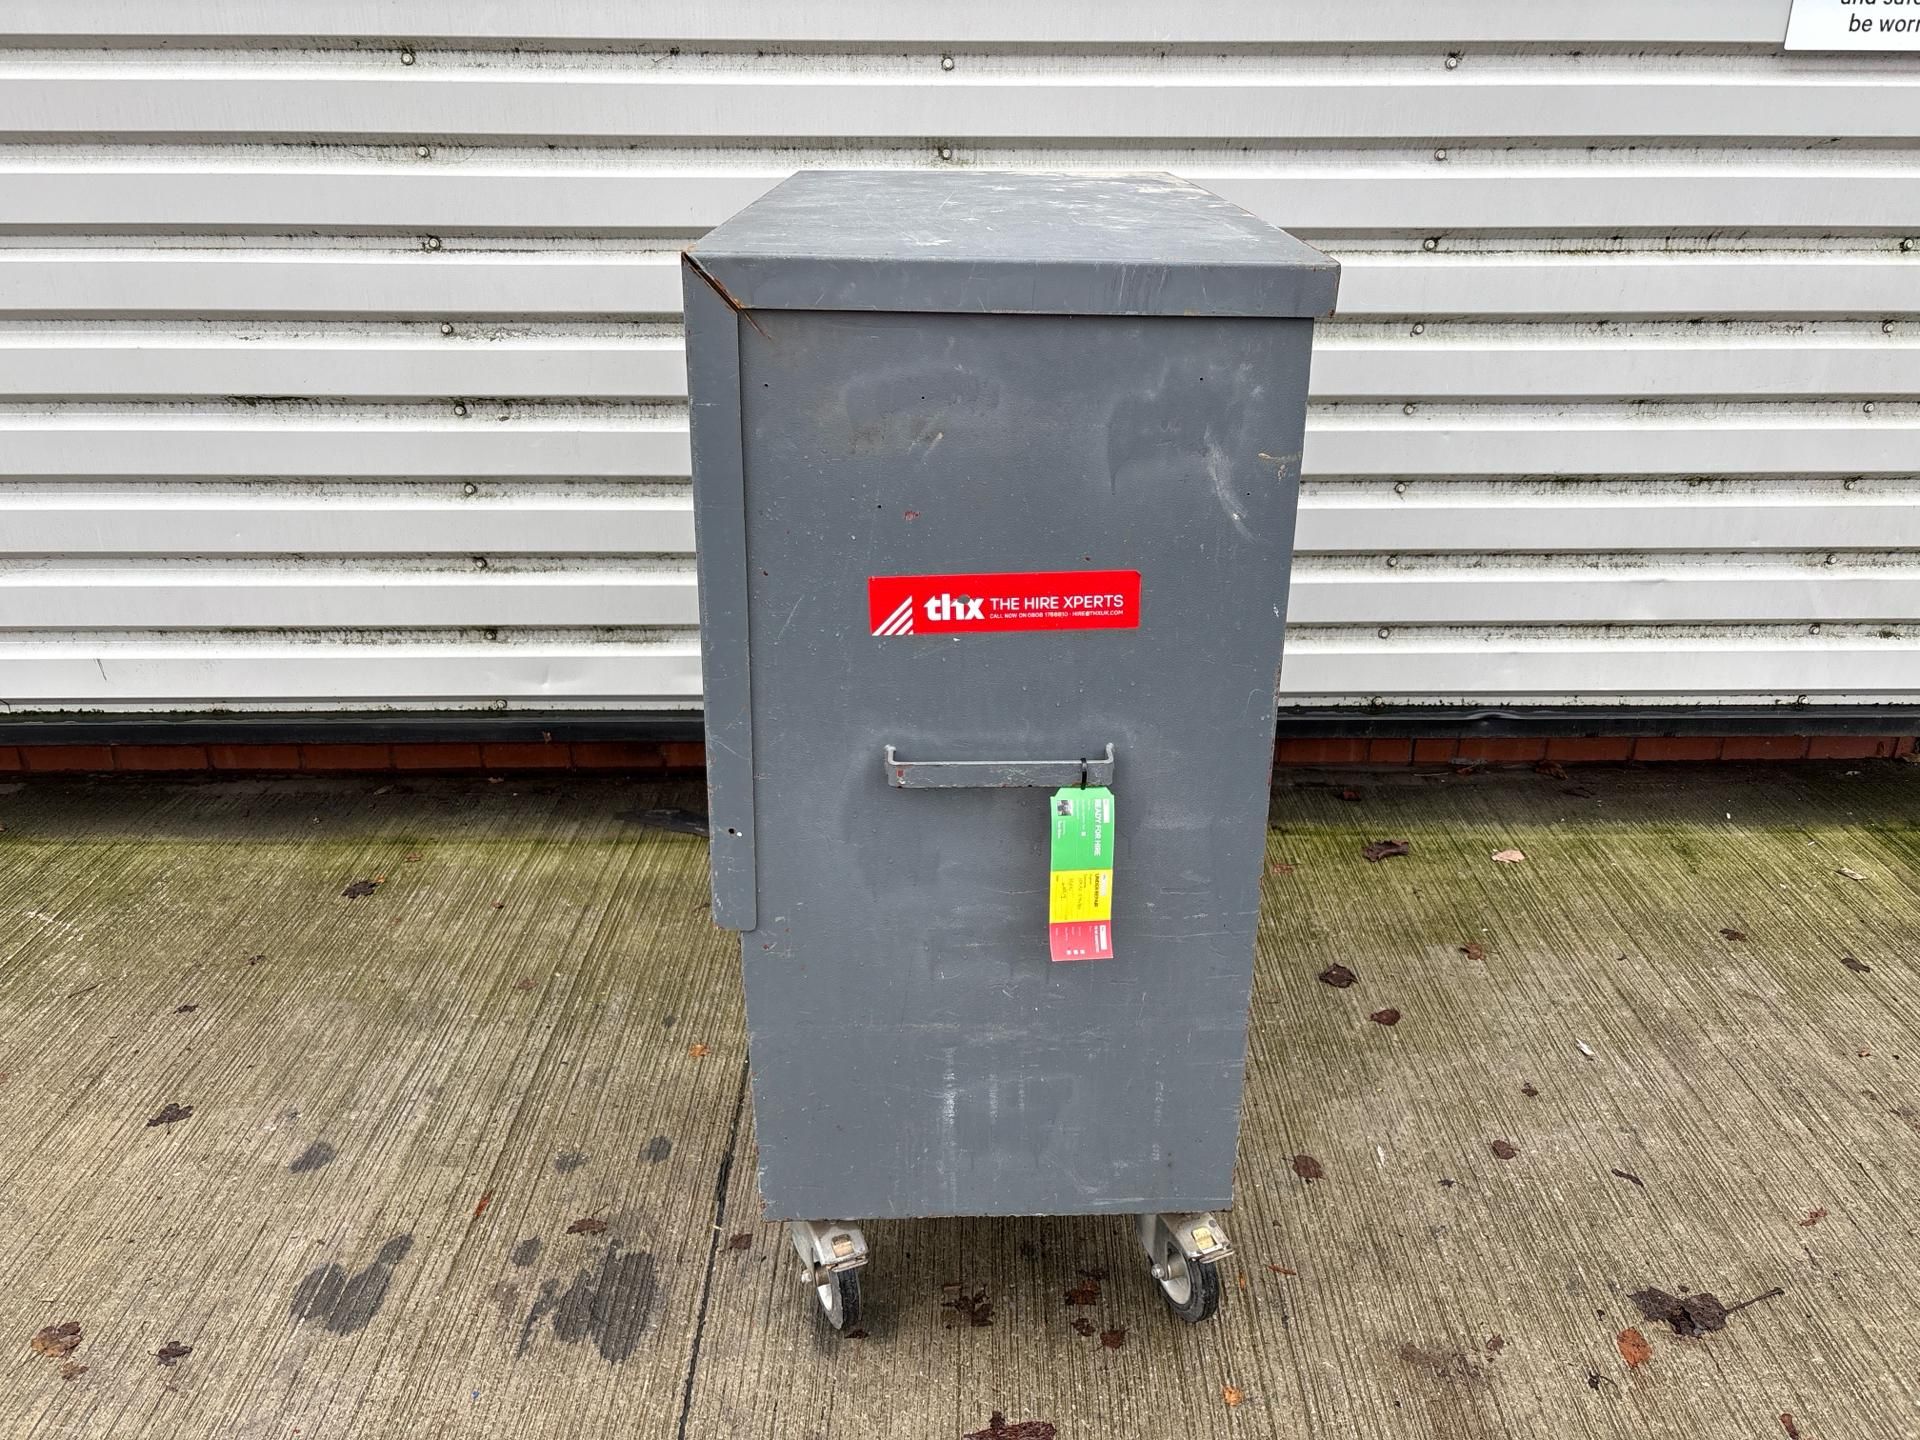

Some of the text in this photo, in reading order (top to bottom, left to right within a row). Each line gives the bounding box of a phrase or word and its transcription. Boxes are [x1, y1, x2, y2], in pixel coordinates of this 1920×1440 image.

[1848, 13, 1873, 33] be
[990, 594, 1124, 610] THE HIRE XPERTS
[1094, 825, 1102, 839] FOR
